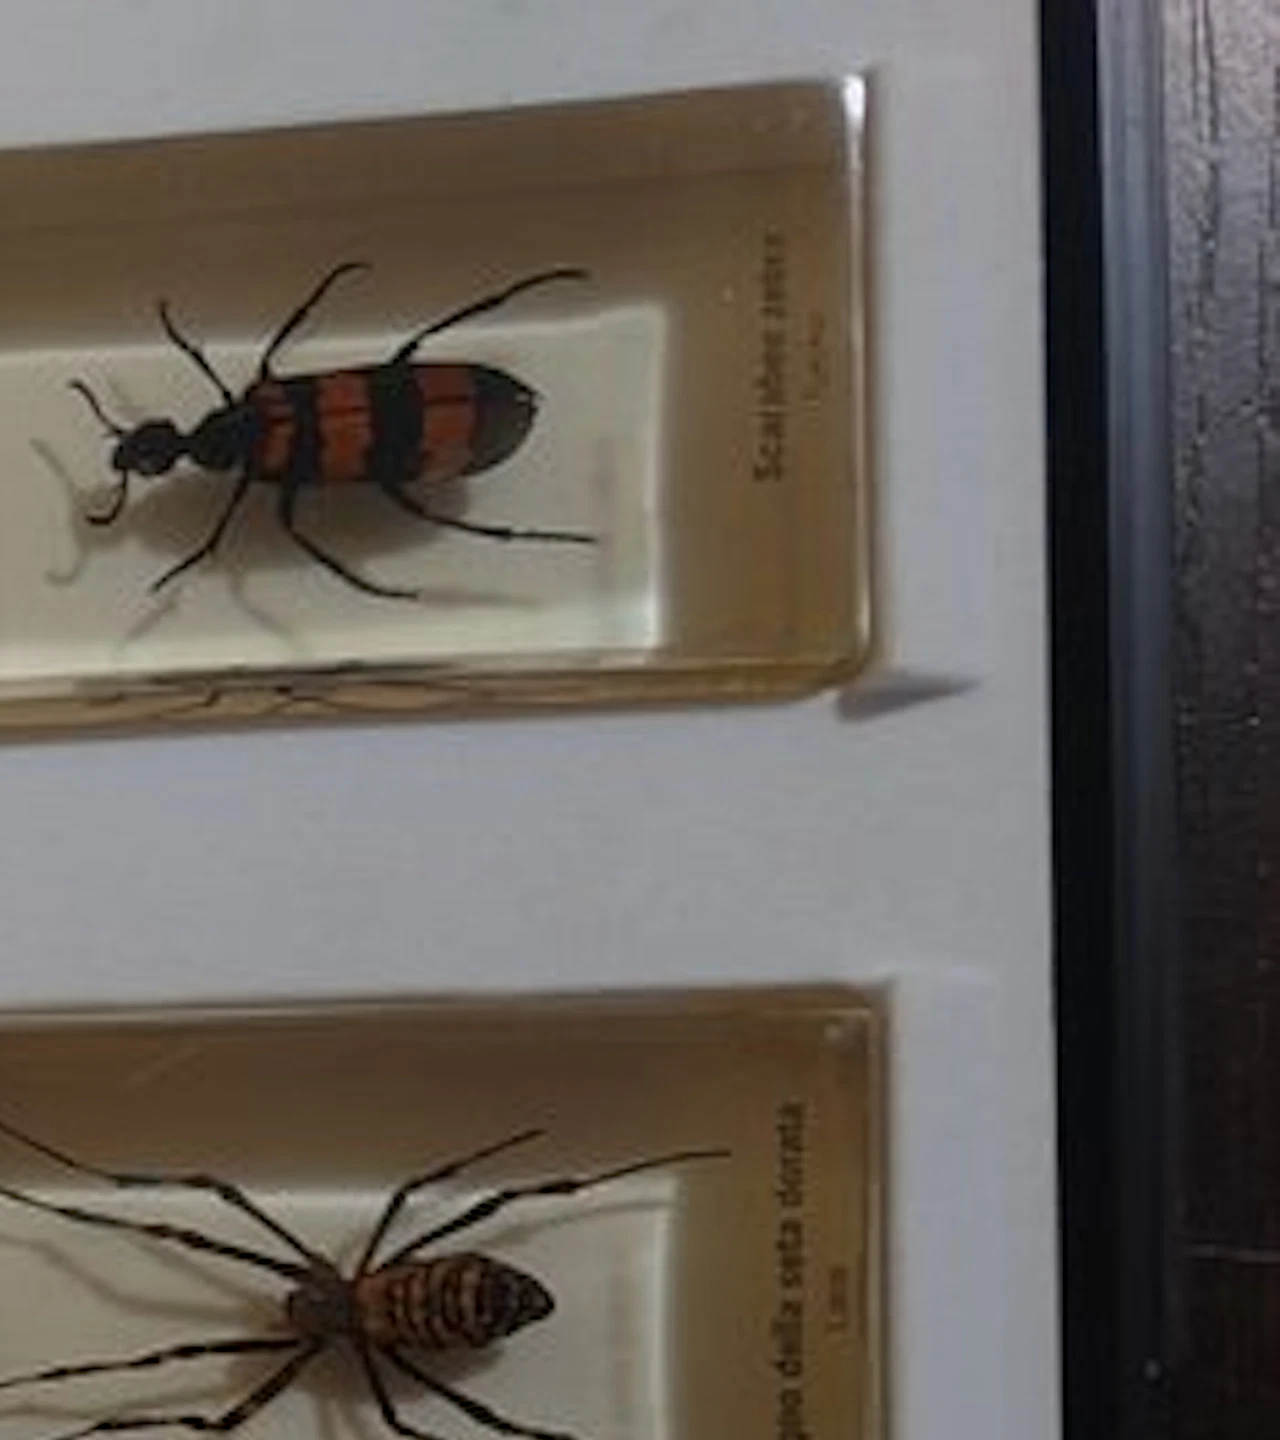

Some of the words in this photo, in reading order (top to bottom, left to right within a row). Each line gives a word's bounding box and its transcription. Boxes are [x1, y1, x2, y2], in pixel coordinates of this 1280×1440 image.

[770, 1100, 804, 1208] dorata
[773, 1220, 804, 1290] seta
[768, 1300, 804, 1378] della
